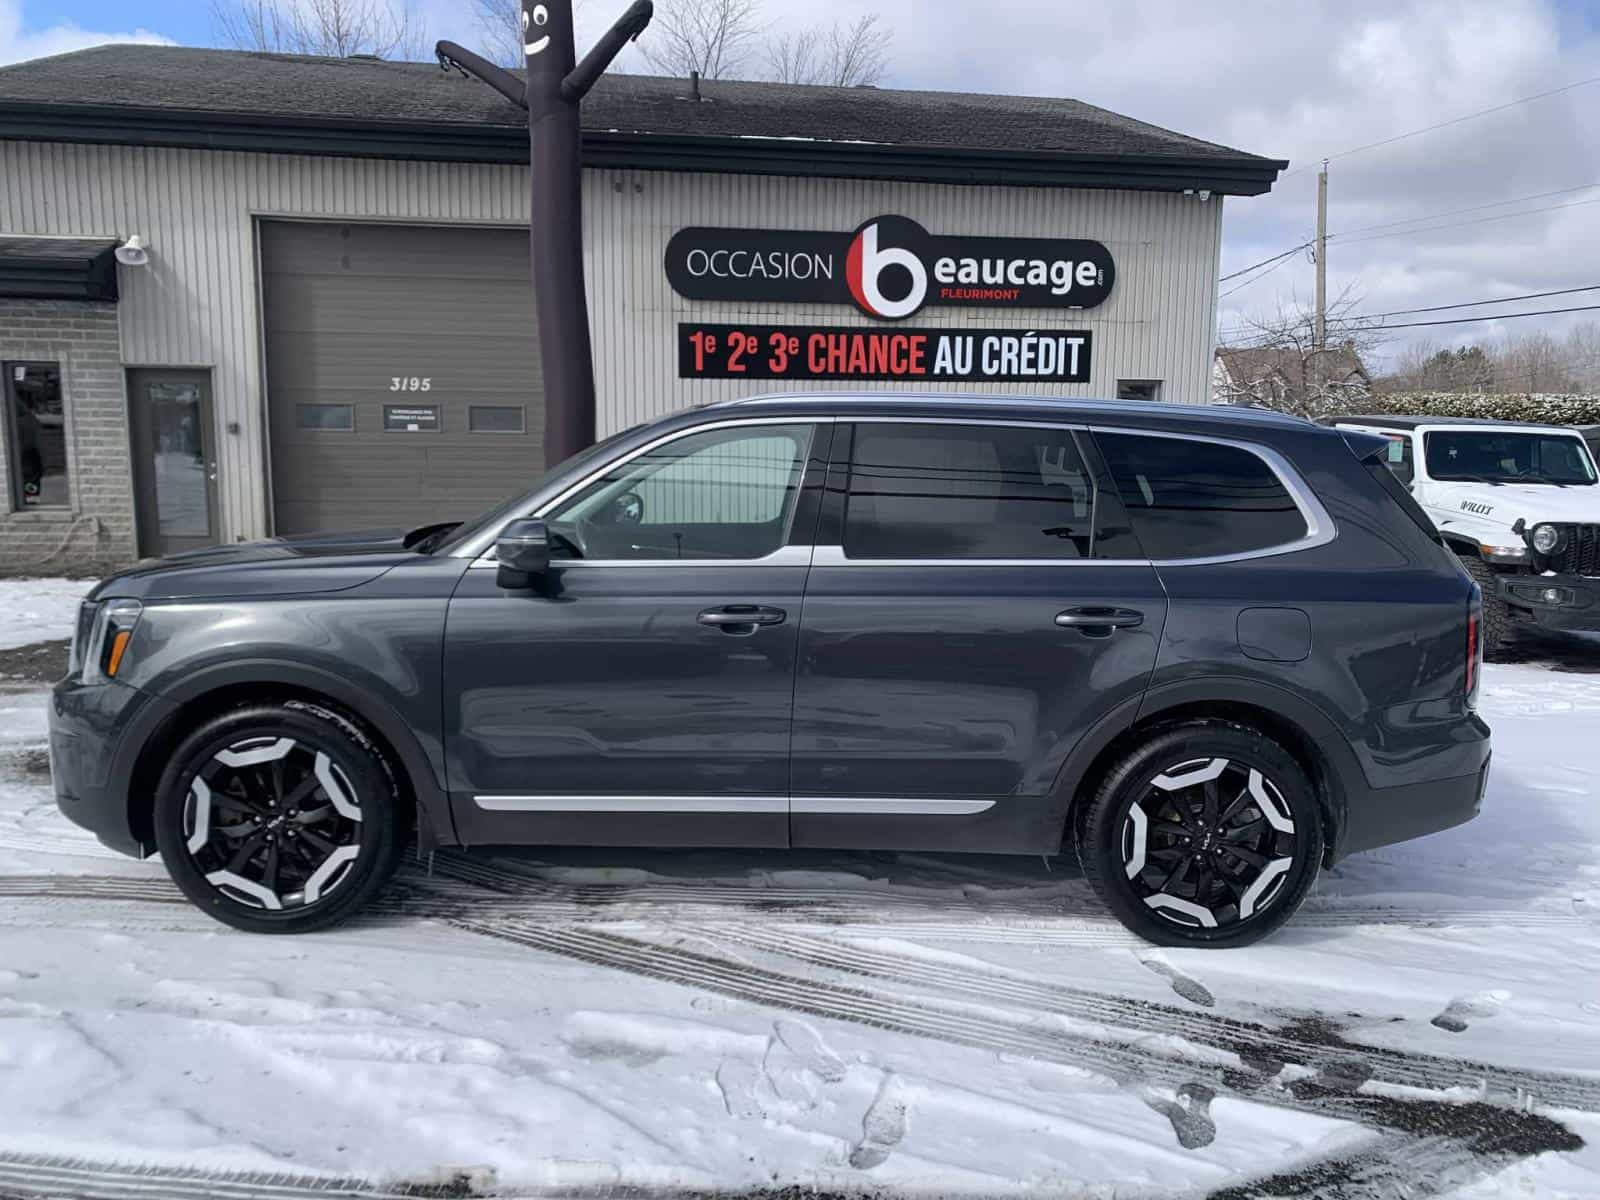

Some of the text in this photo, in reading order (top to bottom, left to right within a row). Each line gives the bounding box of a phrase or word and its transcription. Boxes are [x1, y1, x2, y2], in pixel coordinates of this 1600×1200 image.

[686, 249, 833, 280] OCCASION
[940, 287, 1020, 301] FLEURIMONT
[807, 333, 928, 375] CHANCE
[933, 335, 973, 376] AU
[981, 331, 1085, 377] CRÉDIT
[389, 376, 432, 392] 3195
